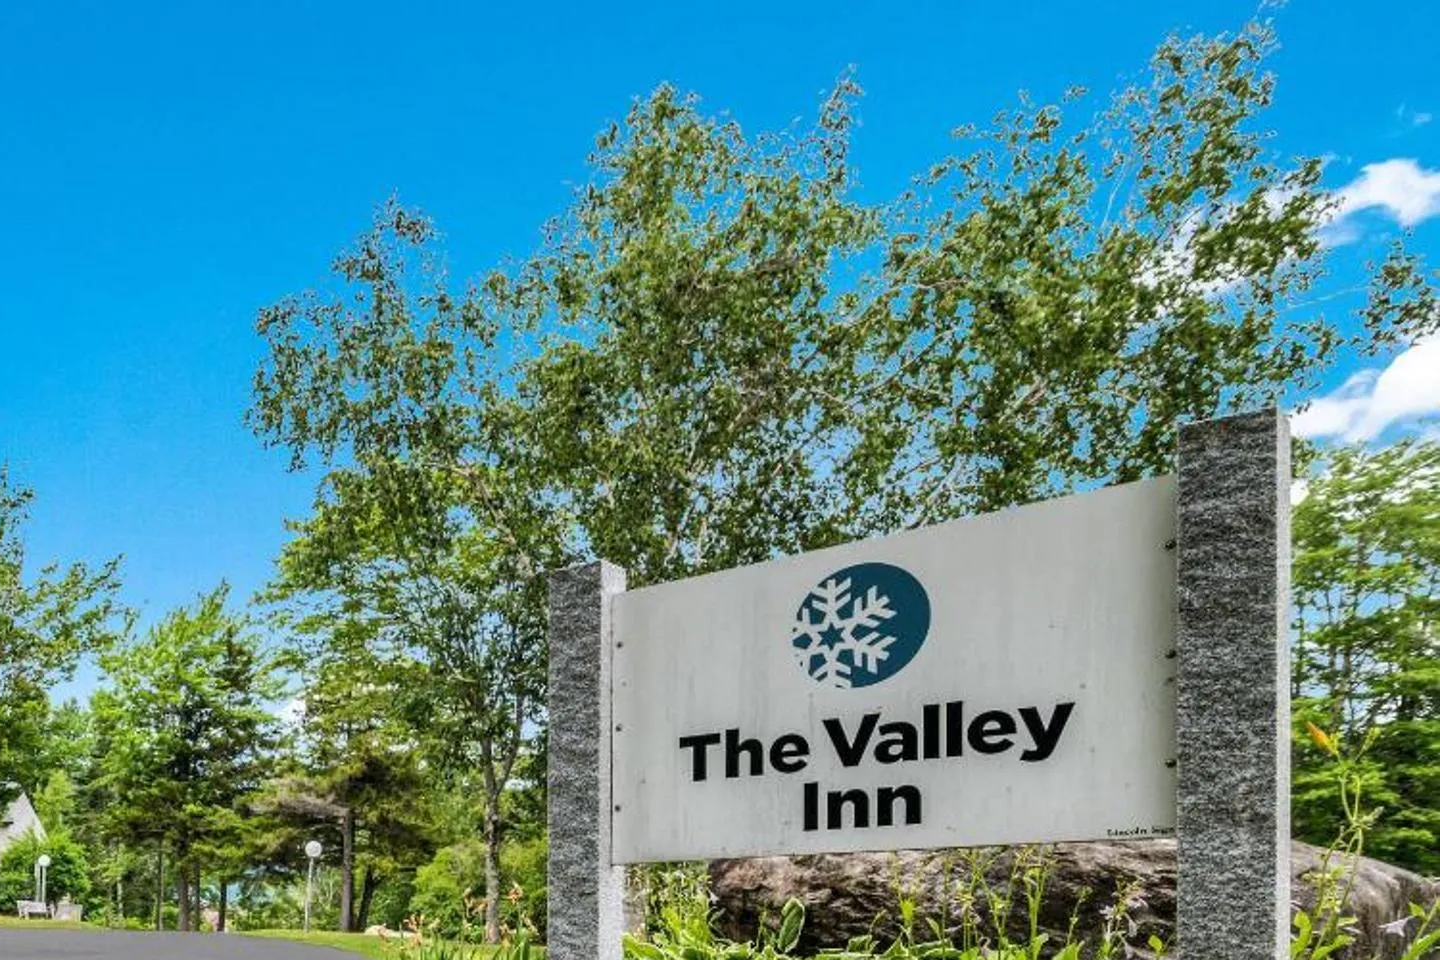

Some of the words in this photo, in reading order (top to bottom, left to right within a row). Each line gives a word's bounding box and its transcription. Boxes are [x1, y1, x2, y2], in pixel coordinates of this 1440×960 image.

[679, 728, 810, 782] The
[821, 700, 1076, 768] Valley
[802, 782, 923, 832] Inn
